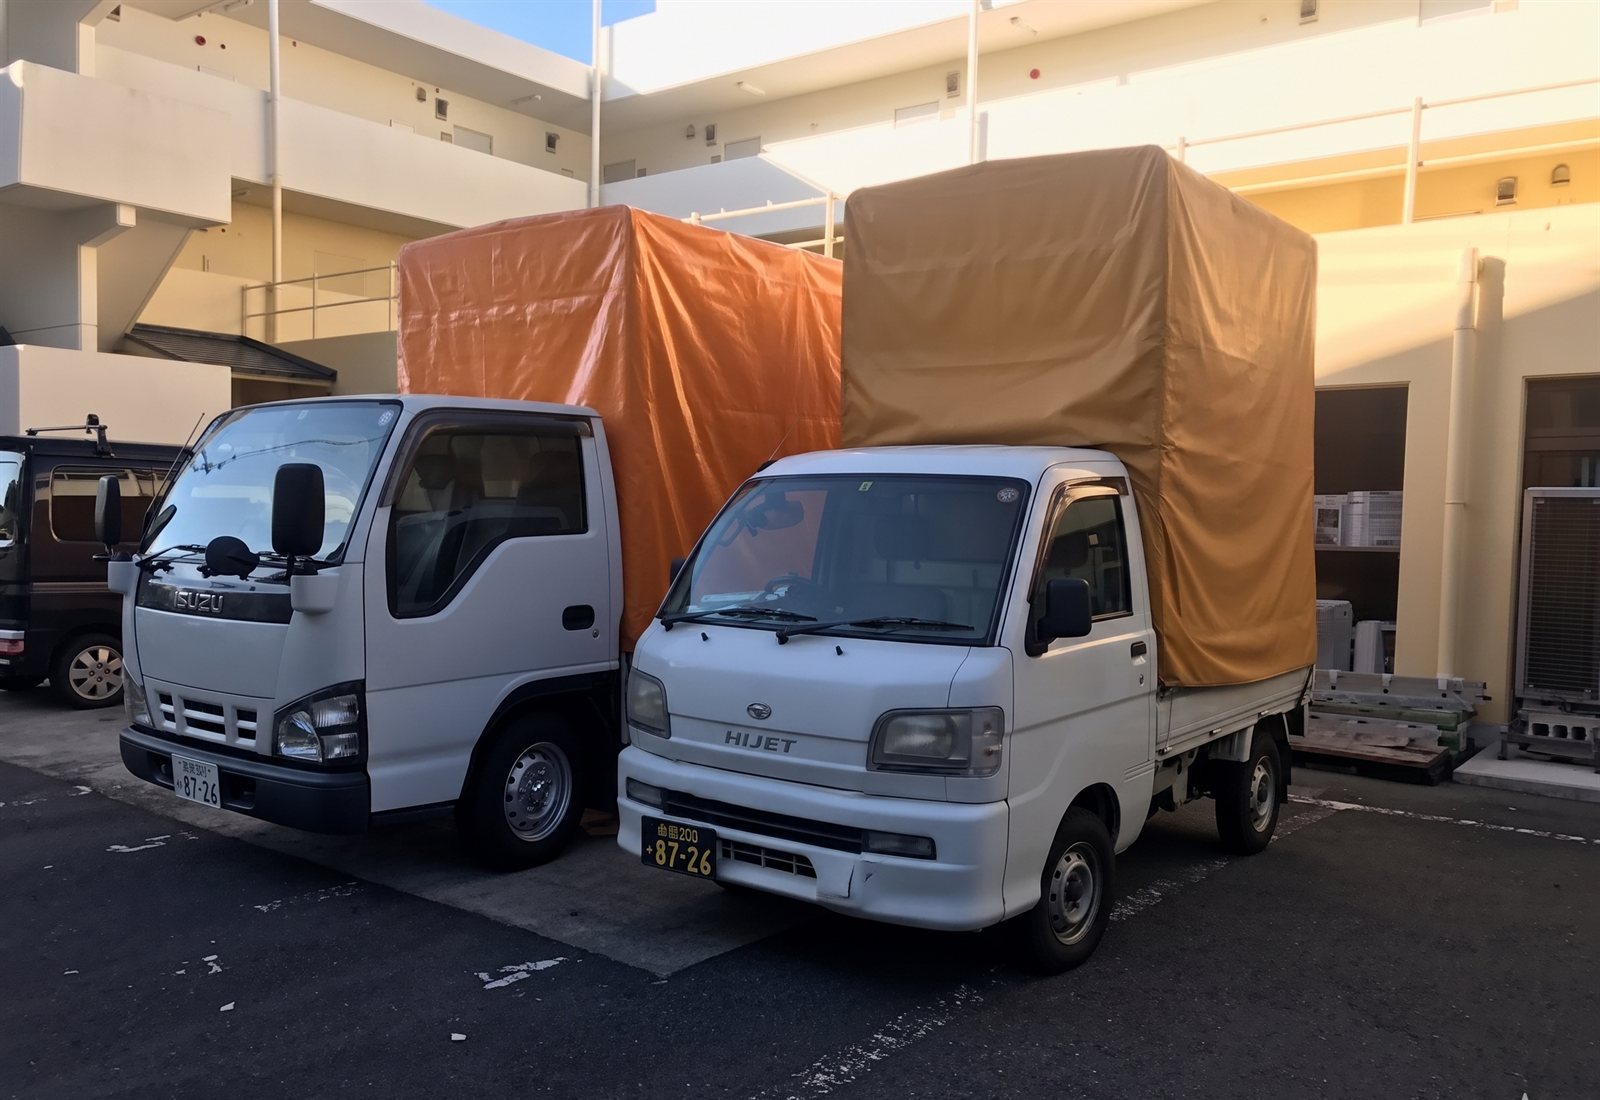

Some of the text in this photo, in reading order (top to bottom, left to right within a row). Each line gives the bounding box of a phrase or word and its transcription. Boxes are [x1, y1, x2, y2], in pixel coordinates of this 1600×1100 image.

[174, 591, 223, 612] ISUZU
[725, 731, 797, 753] HIJET
[655, 840, 711, 875] 87-26
